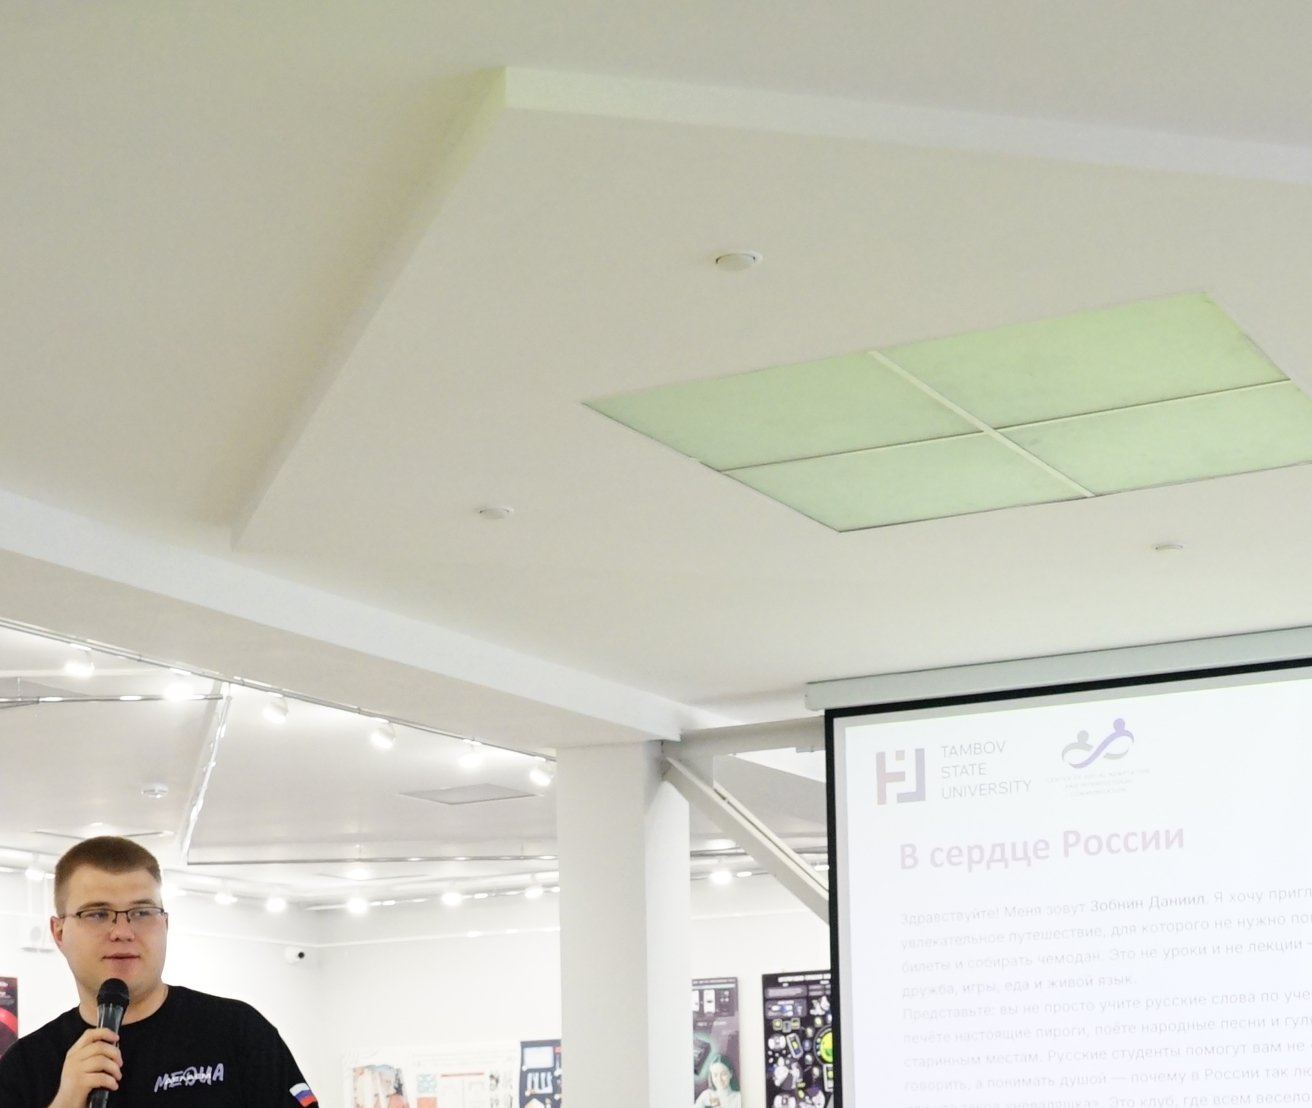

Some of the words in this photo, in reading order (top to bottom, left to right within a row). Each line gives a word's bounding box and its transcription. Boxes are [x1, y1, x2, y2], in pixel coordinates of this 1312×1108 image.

[939, 739, 1006, 758] TAMBOV
[940, 761, 987, 779] STATE
[940, 778, 1031, 799] UNIVERSITY
[899, 842, 919, 870] В
[929, 838, 1050, 871] сердце
[1062, 827, 1184, 858] России
